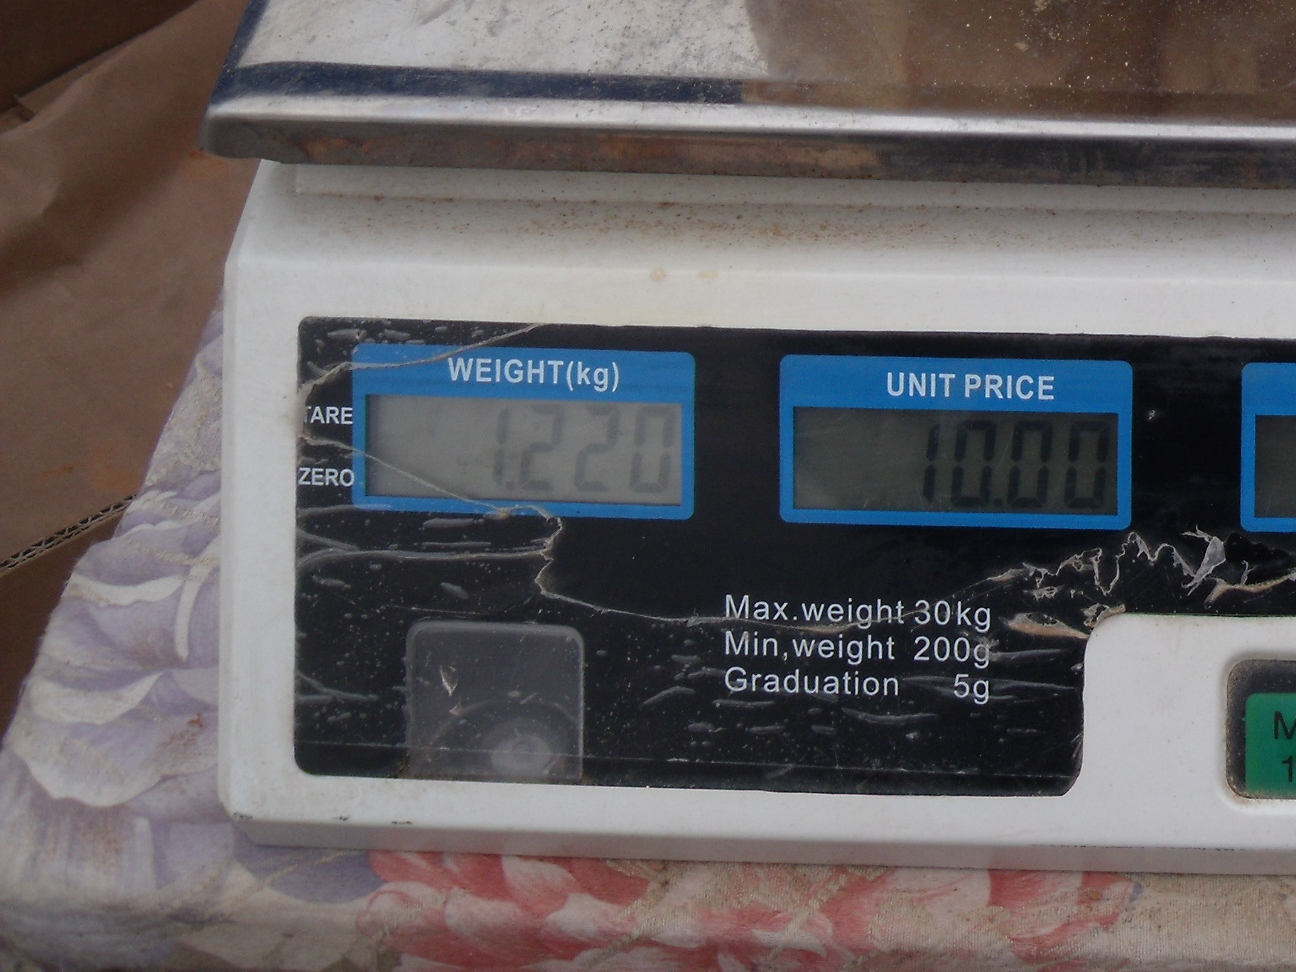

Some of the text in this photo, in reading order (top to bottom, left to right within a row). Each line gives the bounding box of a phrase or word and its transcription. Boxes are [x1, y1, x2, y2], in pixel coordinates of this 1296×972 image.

[448, 358, 620, 392] WEIGHT(kg)
[887, 372, 1055, 400] UNIT PRICE
[298, 467, 355, 487] ZERO
[923, 420, 1110, 510] 10.00
[913, 636, 990, 669] 200g
[724, 666, 990, 704] Graduation 5g
[1281, 757, 1294, 782] 1
